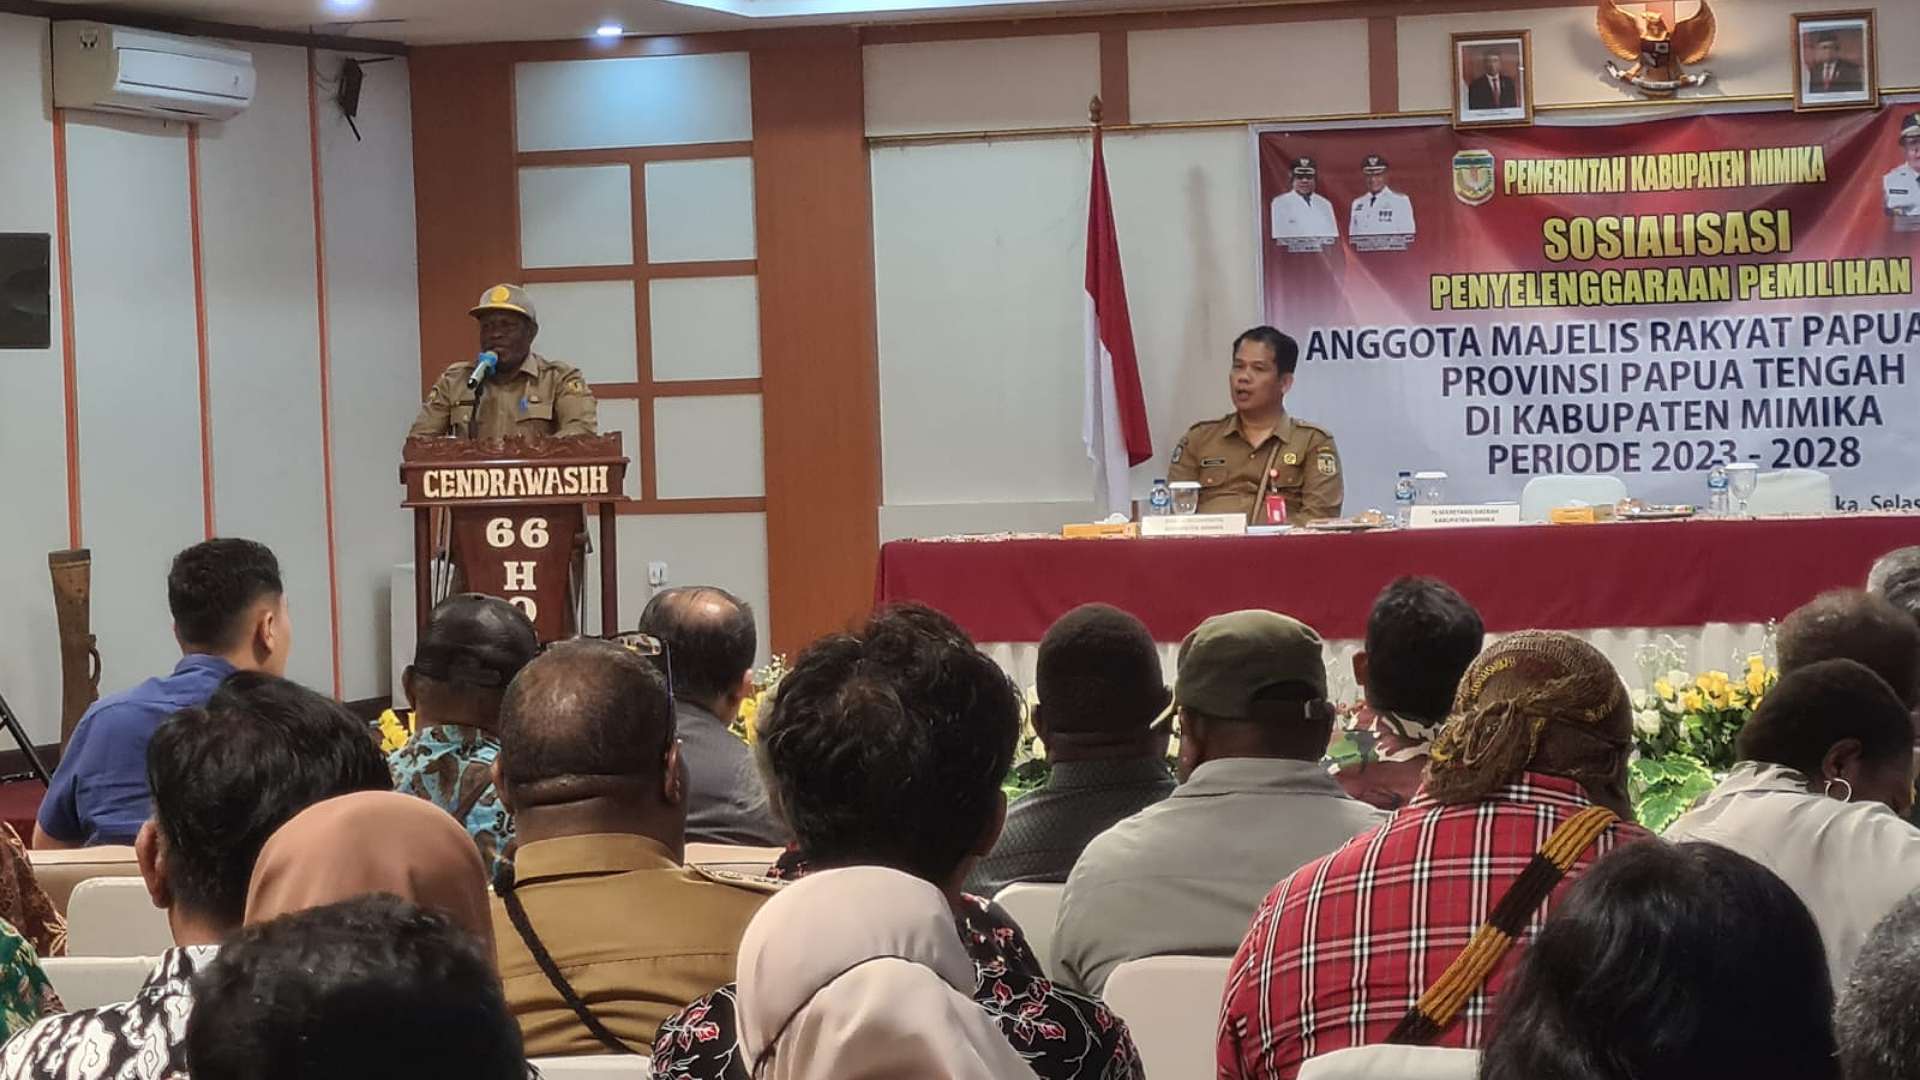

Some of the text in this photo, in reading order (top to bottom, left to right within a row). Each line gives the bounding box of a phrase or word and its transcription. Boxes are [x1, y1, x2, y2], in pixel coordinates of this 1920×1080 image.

[1503, 145, 1827, 195] PEMERINTAH KABUPATEN MIMIKA
[1543, 208, 1793, 263] SOSIALISASI
[1430, 257, 1912, 310] PENYELENGGARAAN PEMILIHAN
[1305, 312, 1920, 361] ANGGOTA MAJELIS RAKYAT PAPUA
[1442, 353, 1905, 397] PROVINSI PAPUA TENGAH
[1466, 394, 1884, 436] DI KABUPATEN MIMIKA
[1488, 442, 1642, 475] PERIODE
[1651, 438, 1738, 472] 2023
[1771, 436, 1861, 469] 2028
[423, 465, 610, 499] CENDRAWASIH
[486, 517, 550, 548] 66
